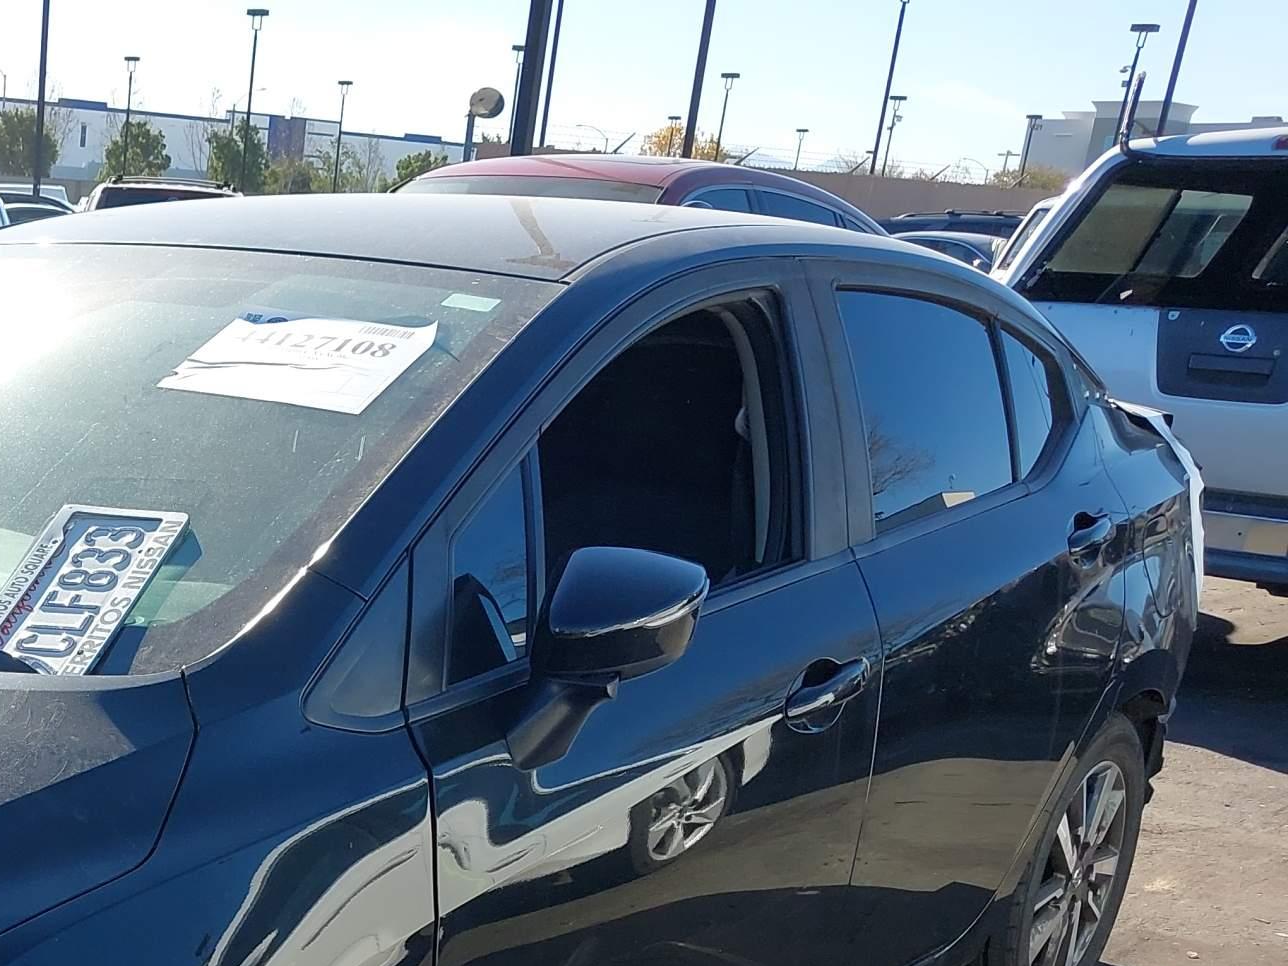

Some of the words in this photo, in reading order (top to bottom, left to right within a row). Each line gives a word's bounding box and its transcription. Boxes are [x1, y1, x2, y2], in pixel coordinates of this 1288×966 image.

[4, 576, 29, 599] AUTO
[21, 543, 53, 576] SQUARE
[62, 596, 132, 676] ERRITOS
[121, 520, 184, 590] NISSAN
